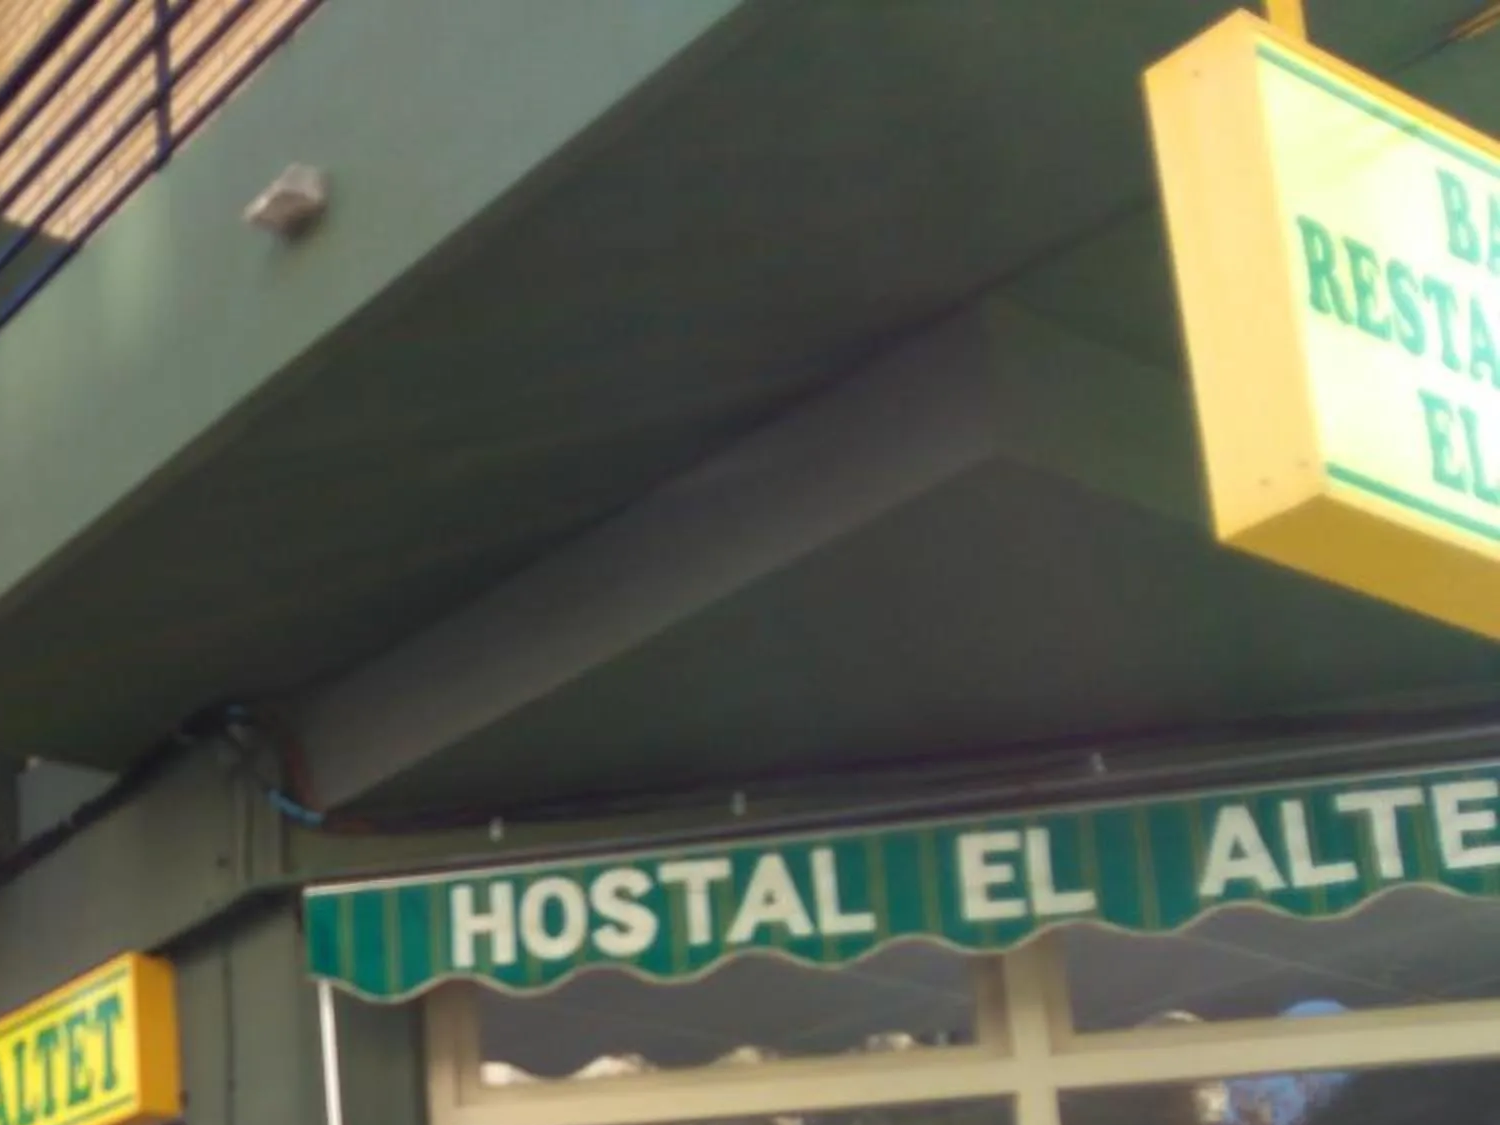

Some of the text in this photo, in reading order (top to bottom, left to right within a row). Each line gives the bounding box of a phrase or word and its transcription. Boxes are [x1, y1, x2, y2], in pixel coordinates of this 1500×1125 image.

[1416, 387, 1500, 506] EL
[450, 778, 1500, 968] HOSTAL EL ALTE
